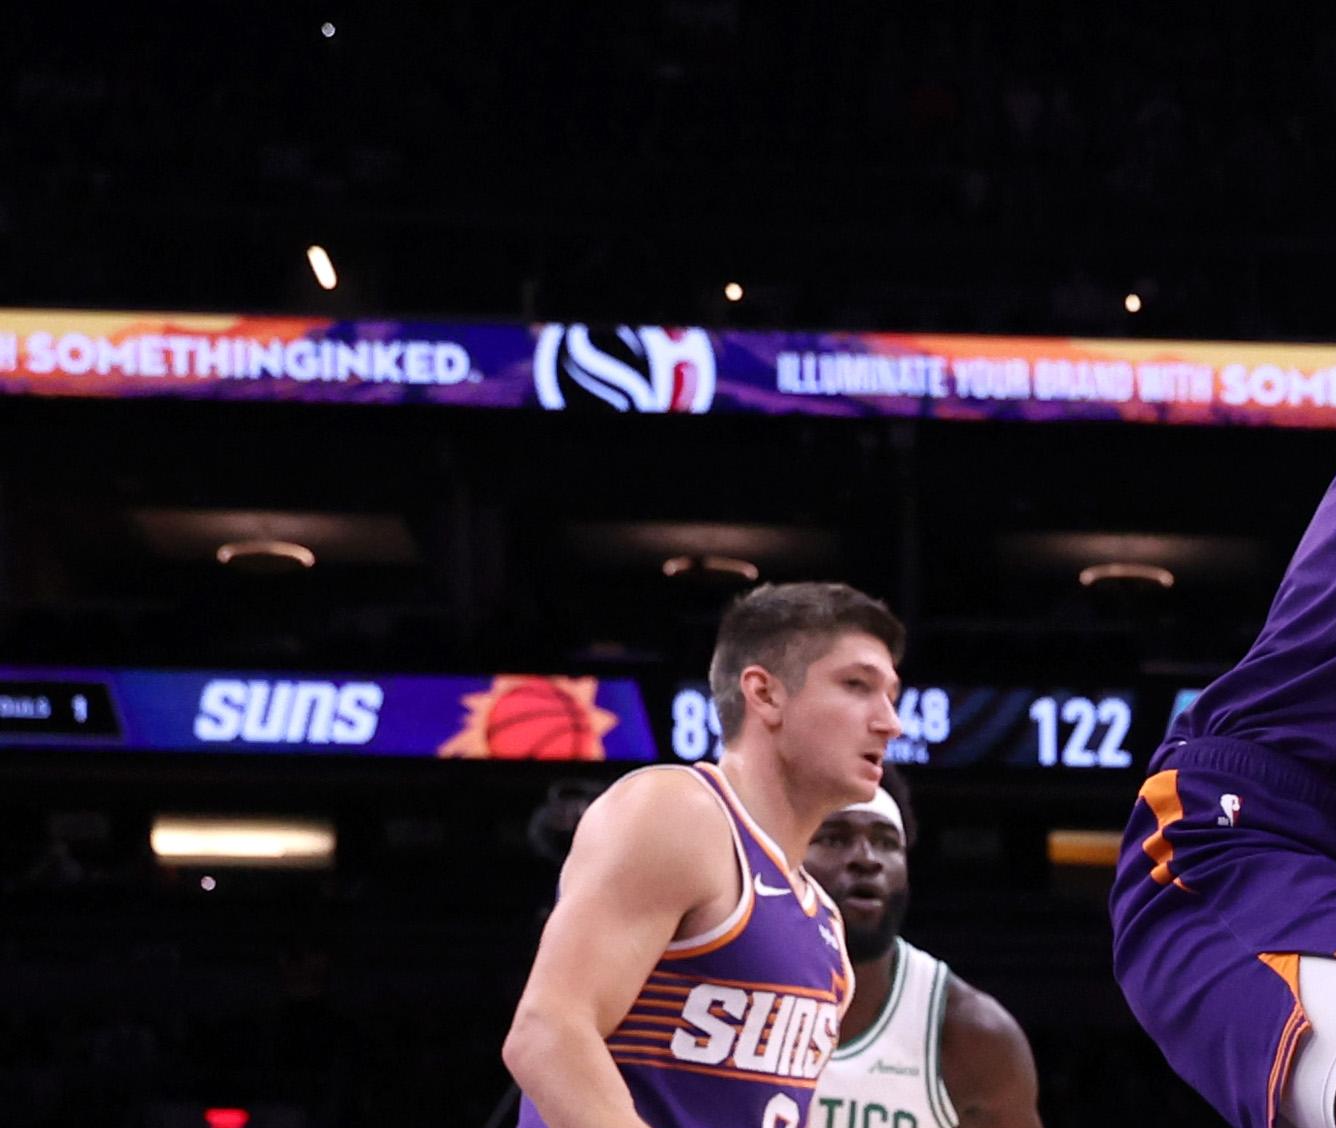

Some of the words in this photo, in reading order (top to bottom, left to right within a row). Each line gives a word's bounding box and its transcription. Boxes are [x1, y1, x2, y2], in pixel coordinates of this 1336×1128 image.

[776, 350, 948, 398] ILLUMINATE
[951, 356, 1031, 400] YOUR
[1034, 357, 1135, 402] BRAND
[1136, 361, 1214, 403] WITH
[194, 678, 384, 745] SUNS
[671, 688, 724, 762] 8
[1029, 696, 1133, 769] 122
[670, 983, 839, 1080] SUNS
